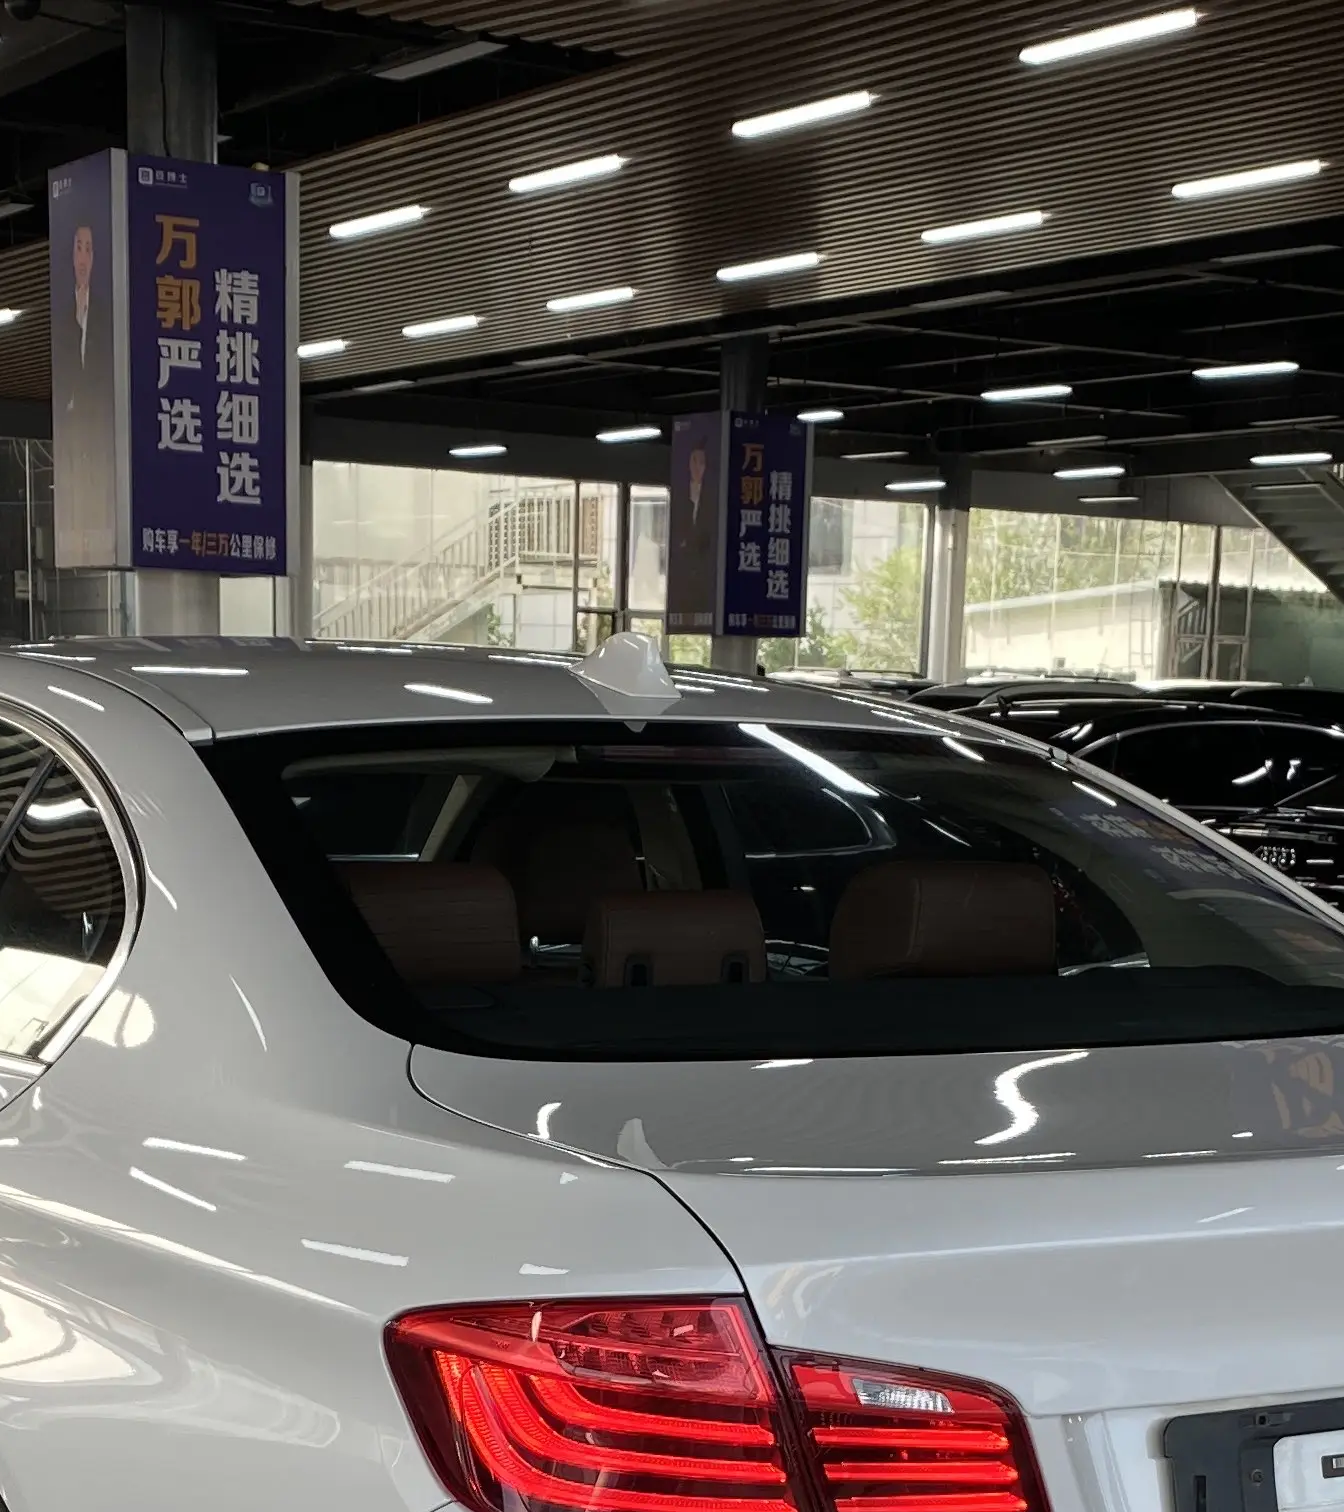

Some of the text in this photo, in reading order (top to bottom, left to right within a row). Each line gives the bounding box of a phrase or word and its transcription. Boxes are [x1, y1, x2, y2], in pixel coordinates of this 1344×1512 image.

[155, 214, 203, 452] 万郭严选
[214, 268, 262, 505] 精挑细选
[738, 443, 764, 573] 万郭严选
[766, 470, 793, 599] 精挑细选
